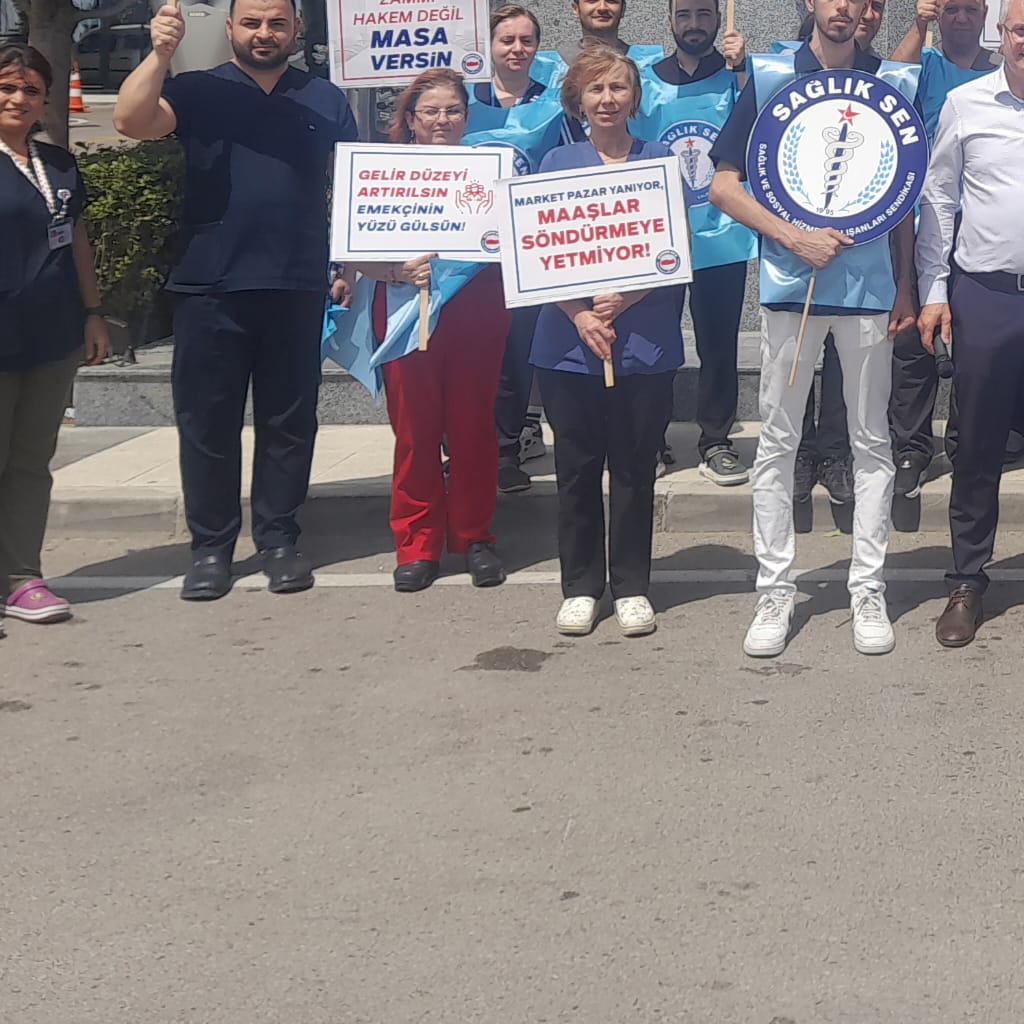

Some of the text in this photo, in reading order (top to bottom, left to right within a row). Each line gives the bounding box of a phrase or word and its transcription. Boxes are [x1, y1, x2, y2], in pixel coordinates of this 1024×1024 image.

[353, 6, 464, 25] HAKEM DEĞİL
[371, 27, 448, 48] MASA
[772, 77, 919, 146] SAĞLIK SEN
[702, 127, 719, 142] SE
[757, 143, 768, 178] SAĞLIK
[358, 168, 469, 181] GELİR DÜZEYİ
[760, 178, 770, 191] VE
[357, 187, 448, 198] ARTIRILSIN
[514, 180, 664, 207] MARKET PAZAR YANIYOR,
[886, 172, 916, 216] SENDİKASI
[357, 202, 444, 217] EMEKÇİNİN
[537, 198, 641, 225] MAAŞLAR
[765, 191, 791, 221] SOSYAL
[357, 220, 467, 232] YÜZÜ GÜLSÜN!
[521, 218, 666, 250] SÖNDÜRMEYE
[539, 242, 651, 271] YETMİYOR!
